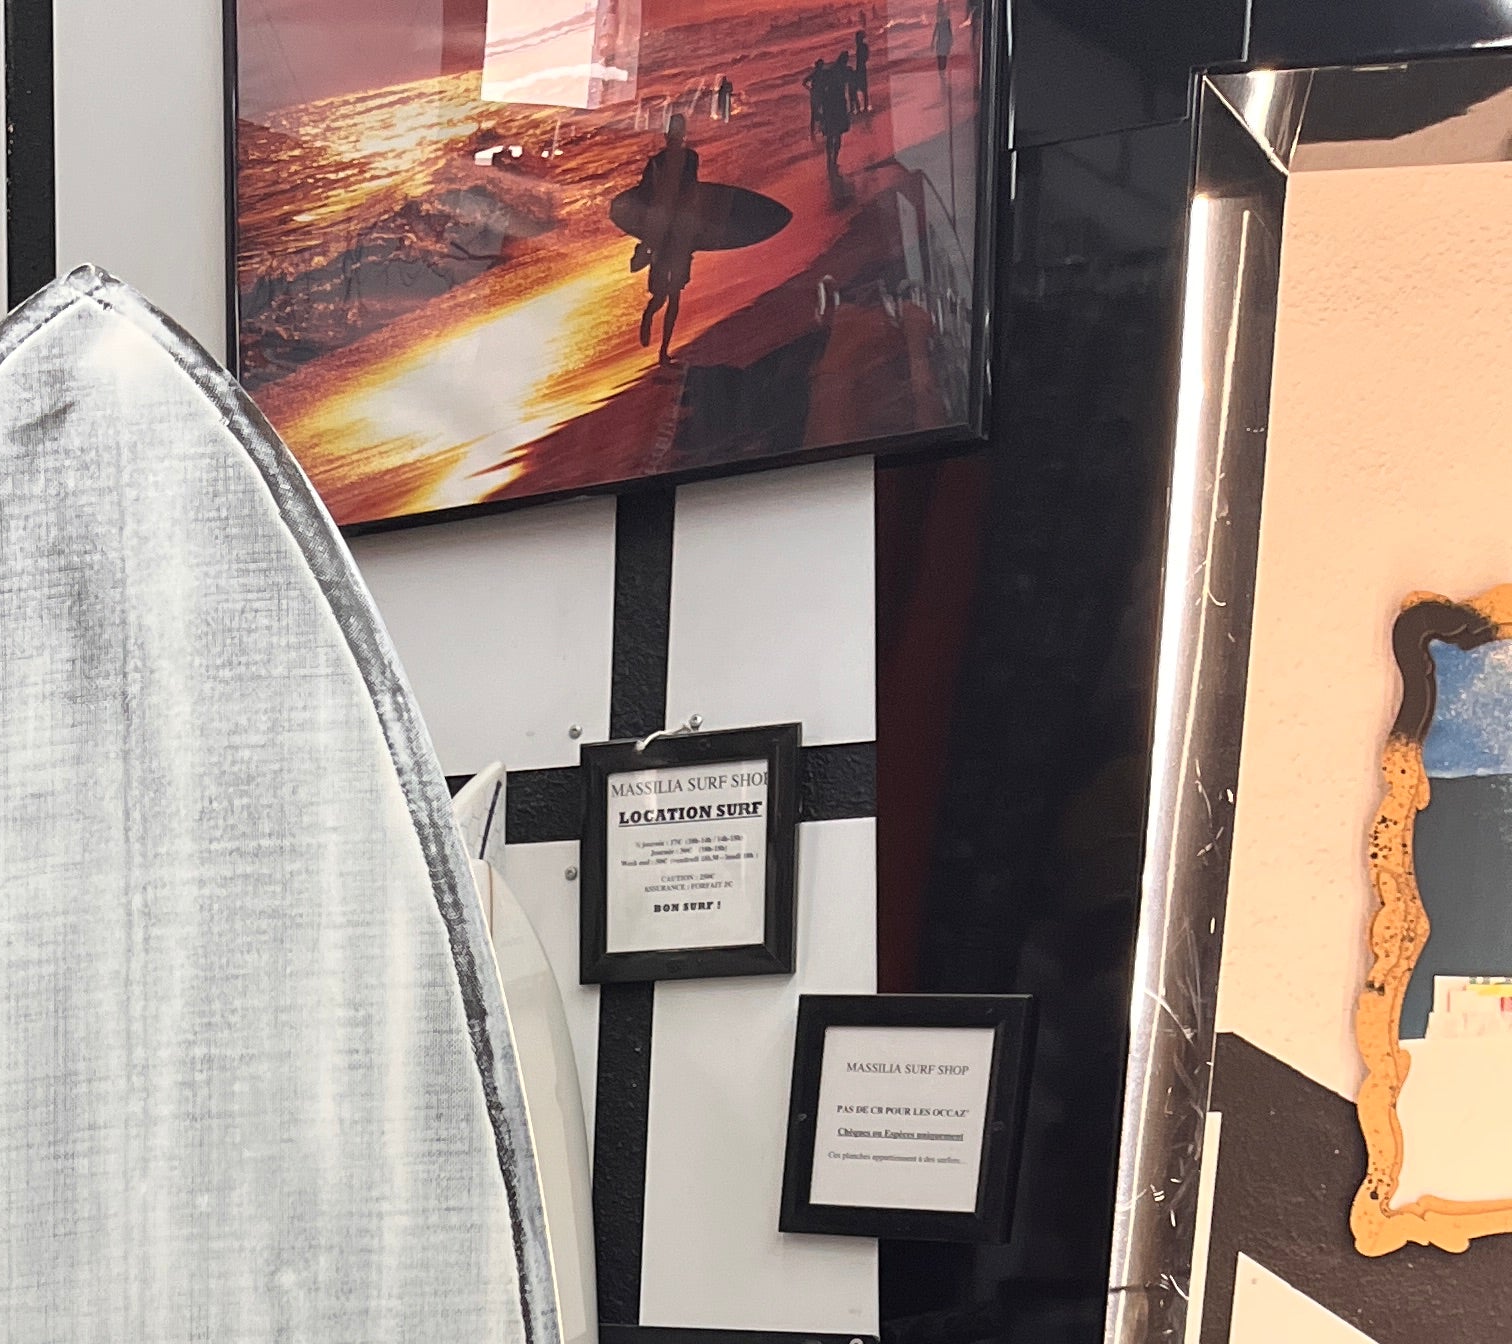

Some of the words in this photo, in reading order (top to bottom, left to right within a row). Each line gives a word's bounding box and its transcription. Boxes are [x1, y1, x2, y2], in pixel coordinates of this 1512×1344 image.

[611, 779, 683, 798] MASSILIA
[687, 774, 728, 792] SURF
[618, 805, 711, 824] LOCATION
[716, 801, 763, 817] SURF
[653, 903, 680, 913] BON
[682, 901, 714, 911] SURF
[846, 1062, 902, 1075] MASSILIA
[904, 1064, 937, 1075] SURF
[937, 1065, 970, 1076] SHOP
[836, 1104, 854, 1114] PAS
[855, 1105, 869, 1115] DE
[885, 1106, 911, 1117] POUR
[913, 1108, 931, 1117] LES
